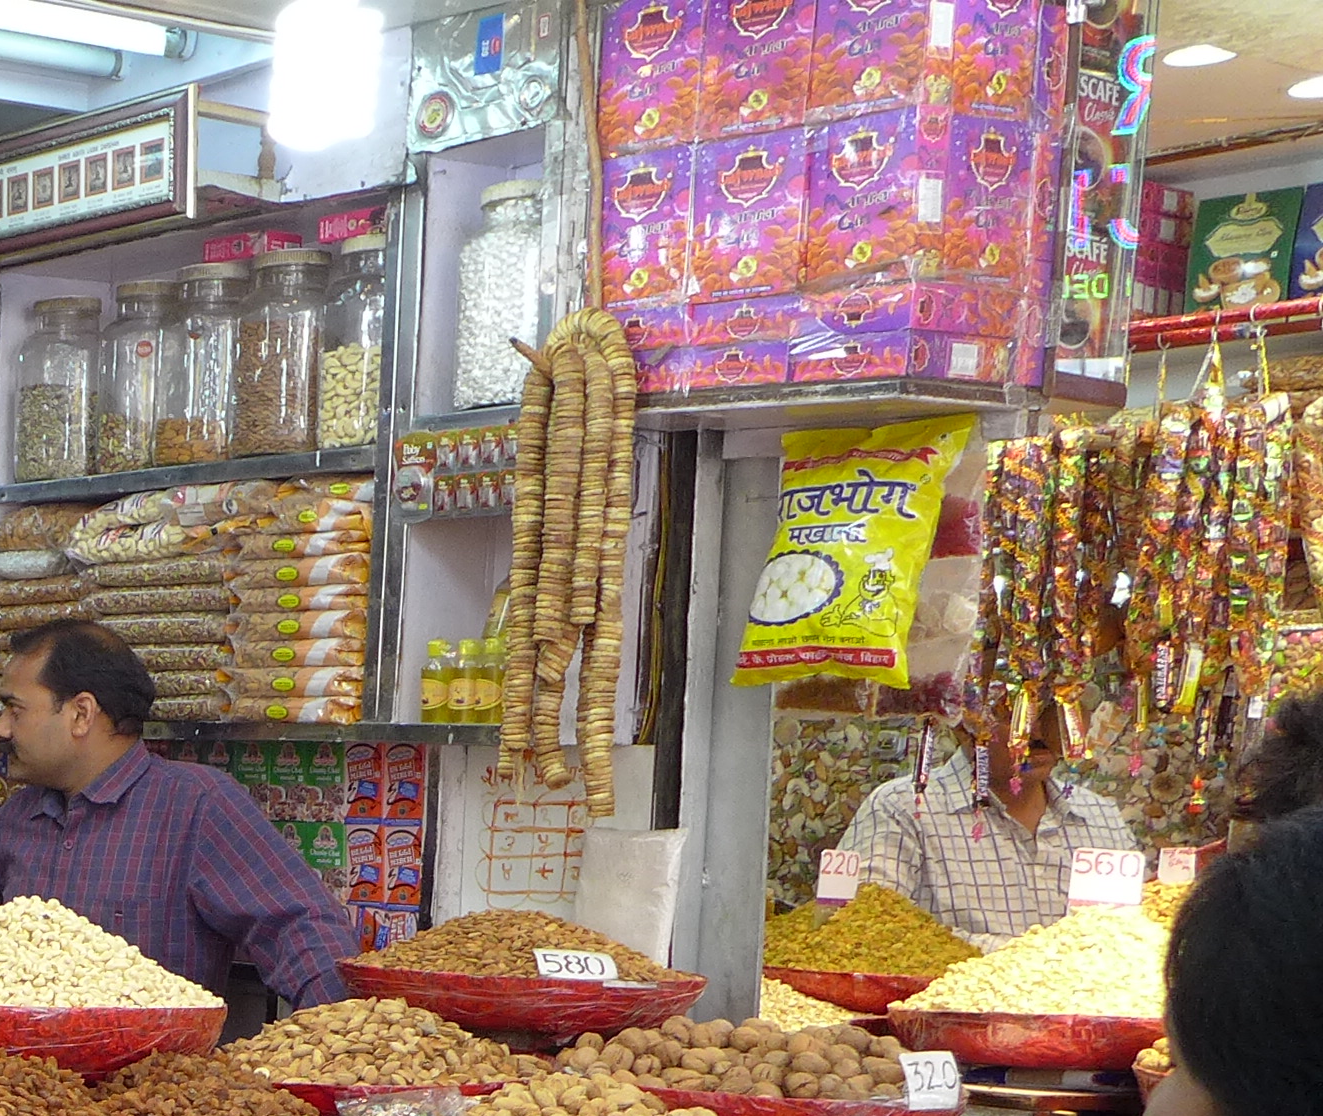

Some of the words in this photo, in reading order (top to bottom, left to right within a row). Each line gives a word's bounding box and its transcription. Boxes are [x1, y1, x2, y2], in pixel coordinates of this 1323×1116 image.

[1079, 73, 1121, 107] SCAFÉ
[820, 852, 860, 877] 220
[1074, 852, 1142, 879] 560
[542, 953, 606, 976] 580
[907, 1060, 957, 1092] 320
